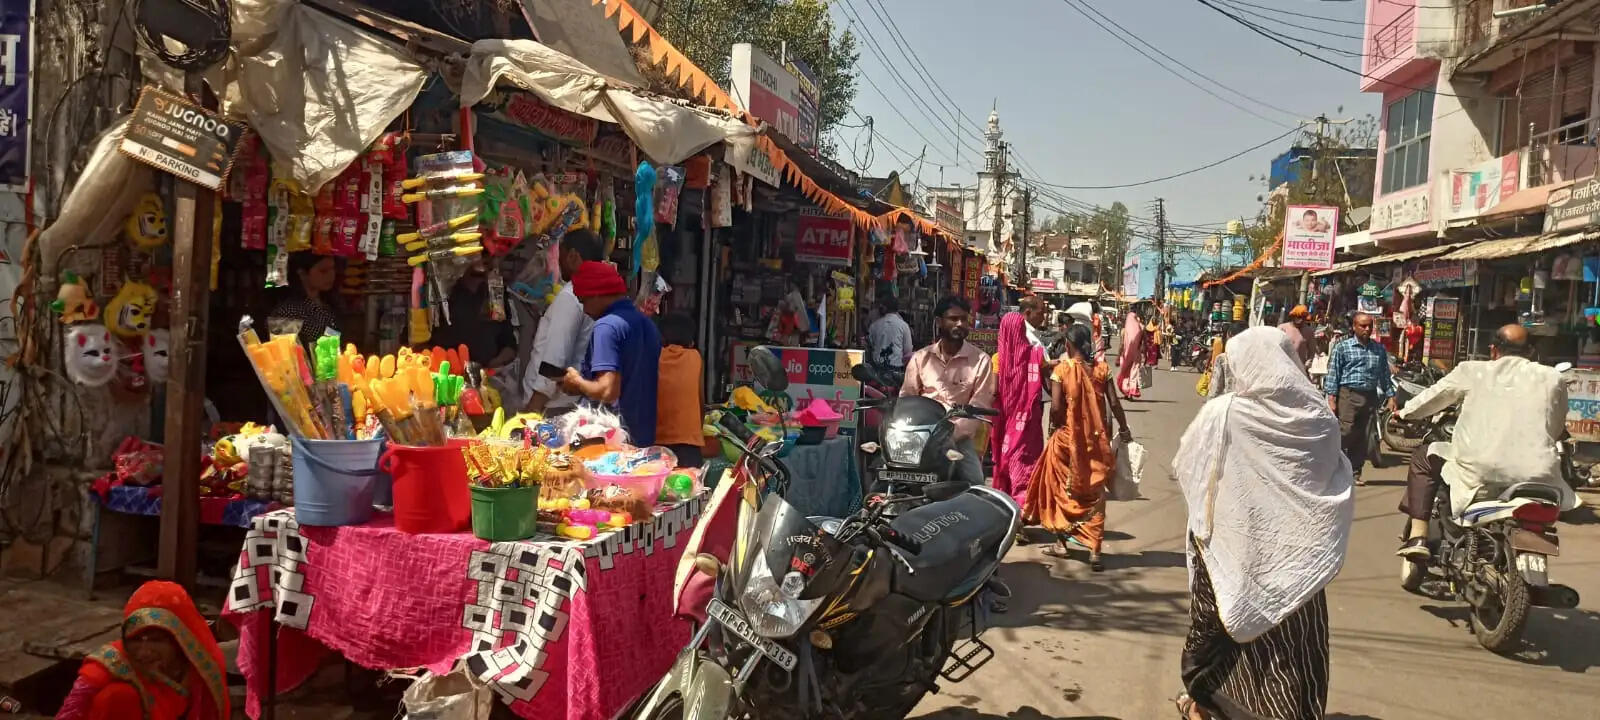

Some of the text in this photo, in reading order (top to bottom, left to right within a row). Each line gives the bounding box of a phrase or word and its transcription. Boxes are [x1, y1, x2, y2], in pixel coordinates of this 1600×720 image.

[752, 63, 778, 93] HITACHI
[165, 103, 228, 137] JUGNOO
[776, 107, 799, 145] ATM
[139, 146, 201, 178] NO PARKING
[801, 227, 849, 247] ATM
[785, 358, 803, 373] Jio
[808, 363, 834, 376] oppo
